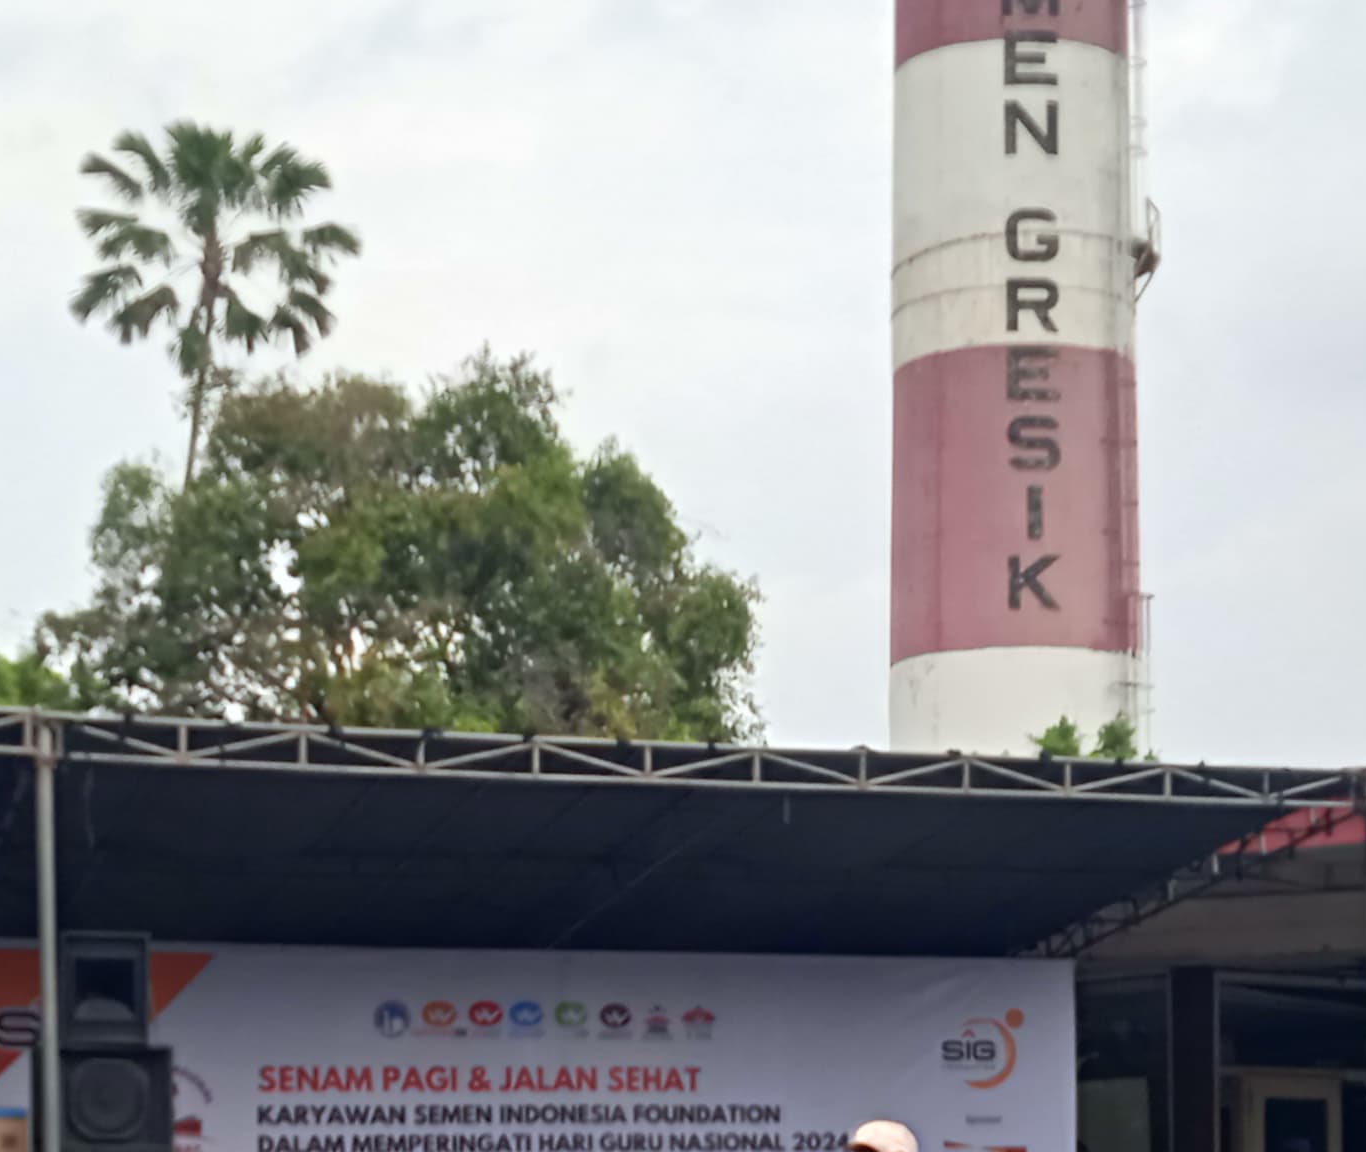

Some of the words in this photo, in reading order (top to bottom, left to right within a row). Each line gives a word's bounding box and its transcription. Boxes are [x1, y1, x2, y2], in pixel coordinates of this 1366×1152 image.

[1004, 207, 1062, 612] GRESIK
[941, 1038, 996, 1062] SIG
[258, 1065, 372, 1093] SENAM
[382, 1065, 458, 1093] PAGI
[467, 1065, 491, 1093] &
[498, 1065, 597, 1093] JALAN
[607, 1065, 701, 1093] SEHAT
[257, 1104, 406, 1125] KARYAWAN
[413, 1104, 492, 1125] SEMEN
[499, 1104, 627, 1124] INDONESIA
[633, 1104, 781, 1124] FOUNDATION
[538, 1133, 593, 1152] HARI
[600, 1133, 663, 1152] GURU
[669, 1133, 784, 1152] NASIONAL
[792, 1132, 848, 1152] 2024
